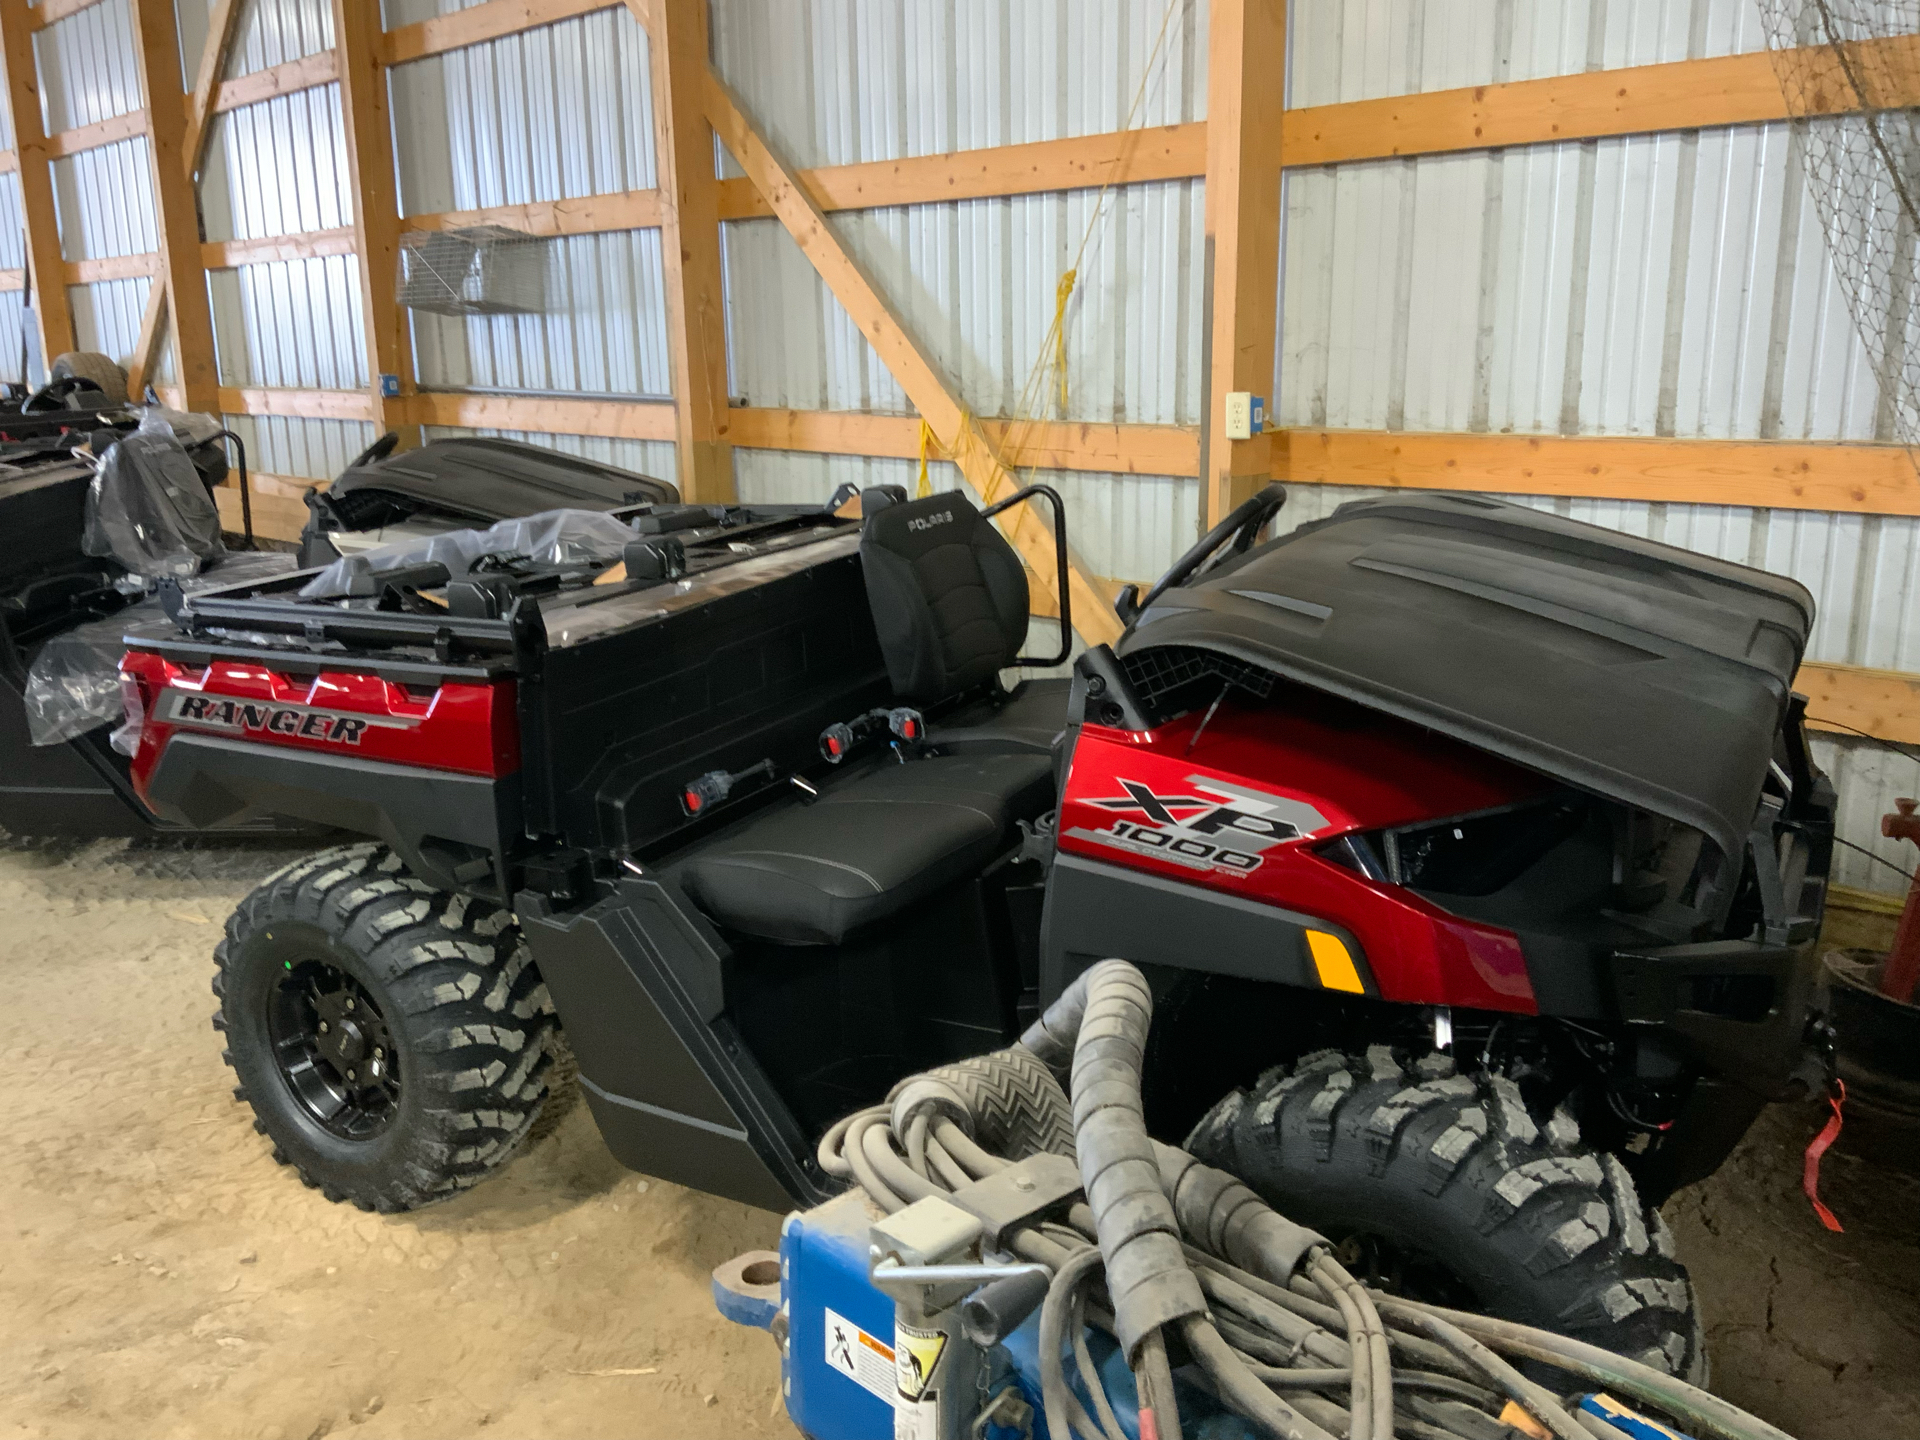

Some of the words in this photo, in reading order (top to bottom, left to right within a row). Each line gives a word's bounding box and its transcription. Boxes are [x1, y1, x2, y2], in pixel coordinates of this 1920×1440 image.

[907, 510, 953, 532] POLARIS
[179, 696, 368, 745] RANGER
[1078, 777, 1303, 843] XP
[1106, 839, 1139, 851] DUAL
[1111, 819, 1264, 873] 1000
